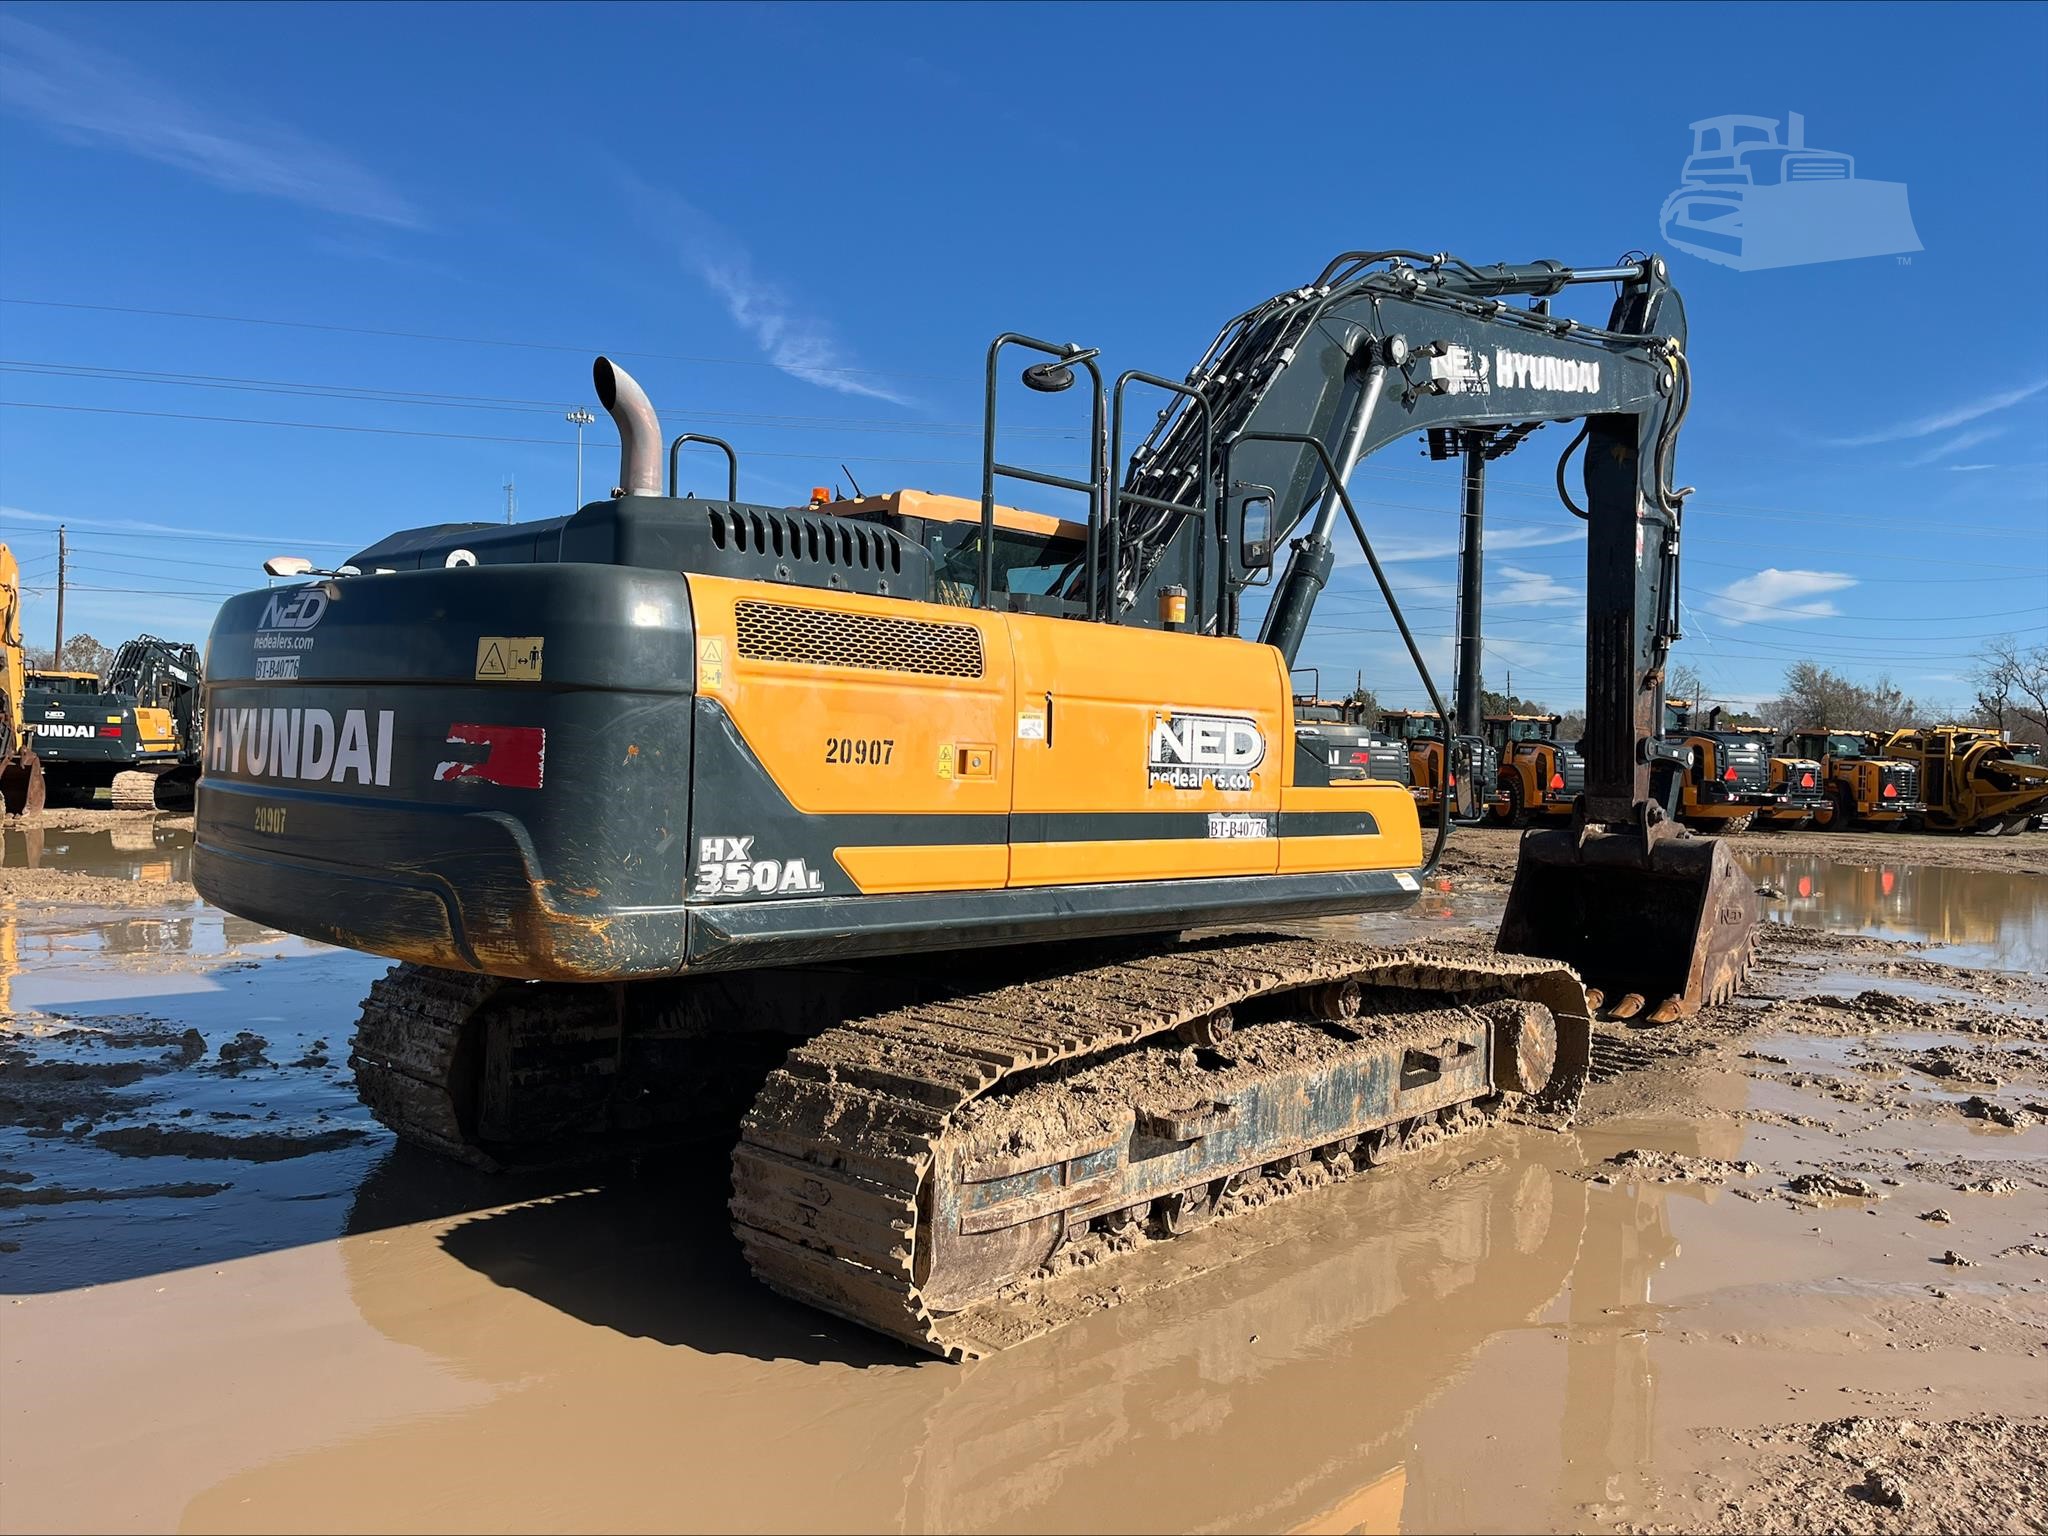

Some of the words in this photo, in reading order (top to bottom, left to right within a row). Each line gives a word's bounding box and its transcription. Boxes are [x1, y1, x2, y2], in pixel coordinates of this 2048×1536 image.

[1496, 348, 1600, 394] HYUNDAI
[257, 590, 329, 631] NED
[253, 632, 315, 650] nedealers.com
[255, 659, 299, 679] BT-B40776
[211, 707, 395, 787] HYUNDAI
[825, 738, 894, 765] 20907
[1150, 717, 1263, 767] NED
[254, 806, 287, 834] 20907
[1210, 820, 1267, 836] BT-B40776
[700, 836, 754, 862] HX
